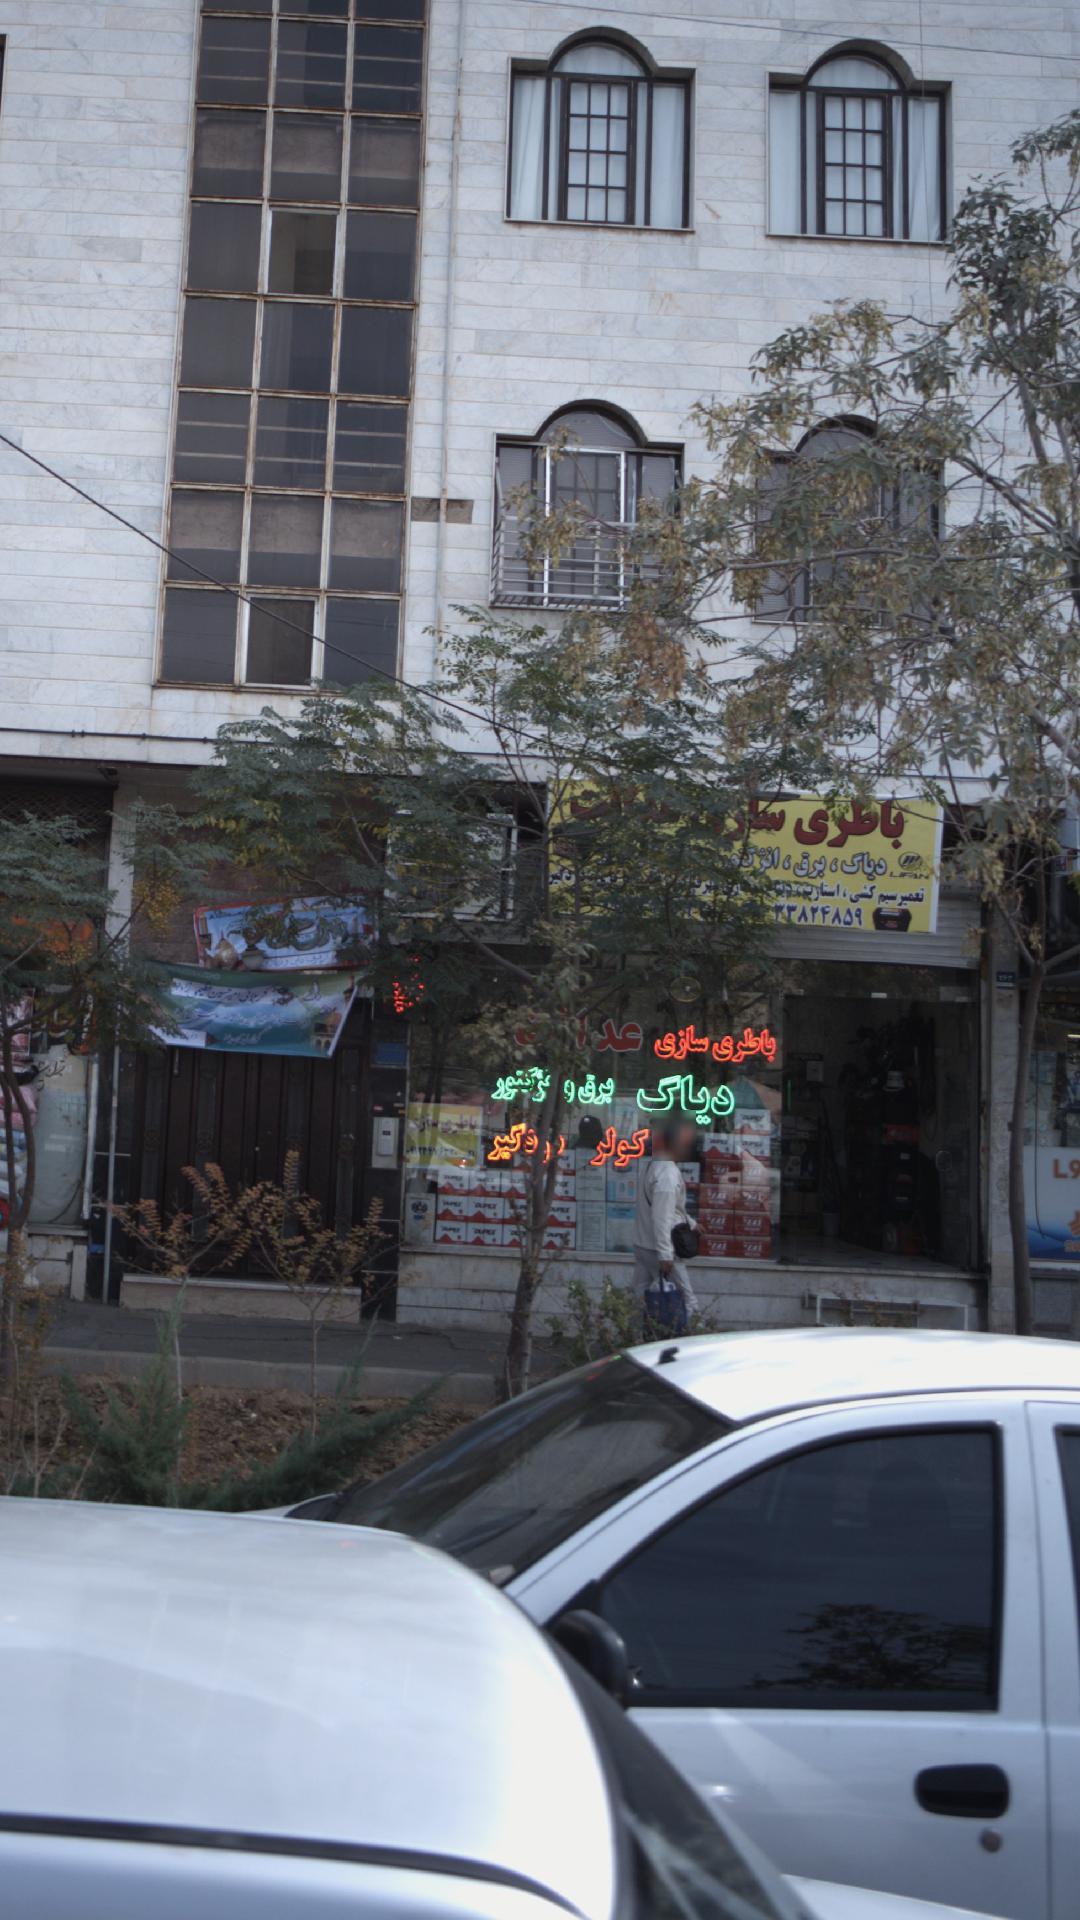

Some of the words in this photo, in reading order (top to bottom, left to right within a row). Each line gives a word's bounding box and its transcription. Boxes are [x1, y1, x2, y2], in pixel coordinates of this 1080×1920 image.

[793, 799, 904, 849] باطری
[513, 1005, 644, 1051] عدا
[653, 1024, 710, 1060] سازی
[712, 1027, 777, 1062] باطری
[563, 1078, 577, 1104] و
[577, 1072, 615, 1105] برق
[636, 1073, 736, 1126] دیاگ
[590, 1126, 650, 1167] کولر
